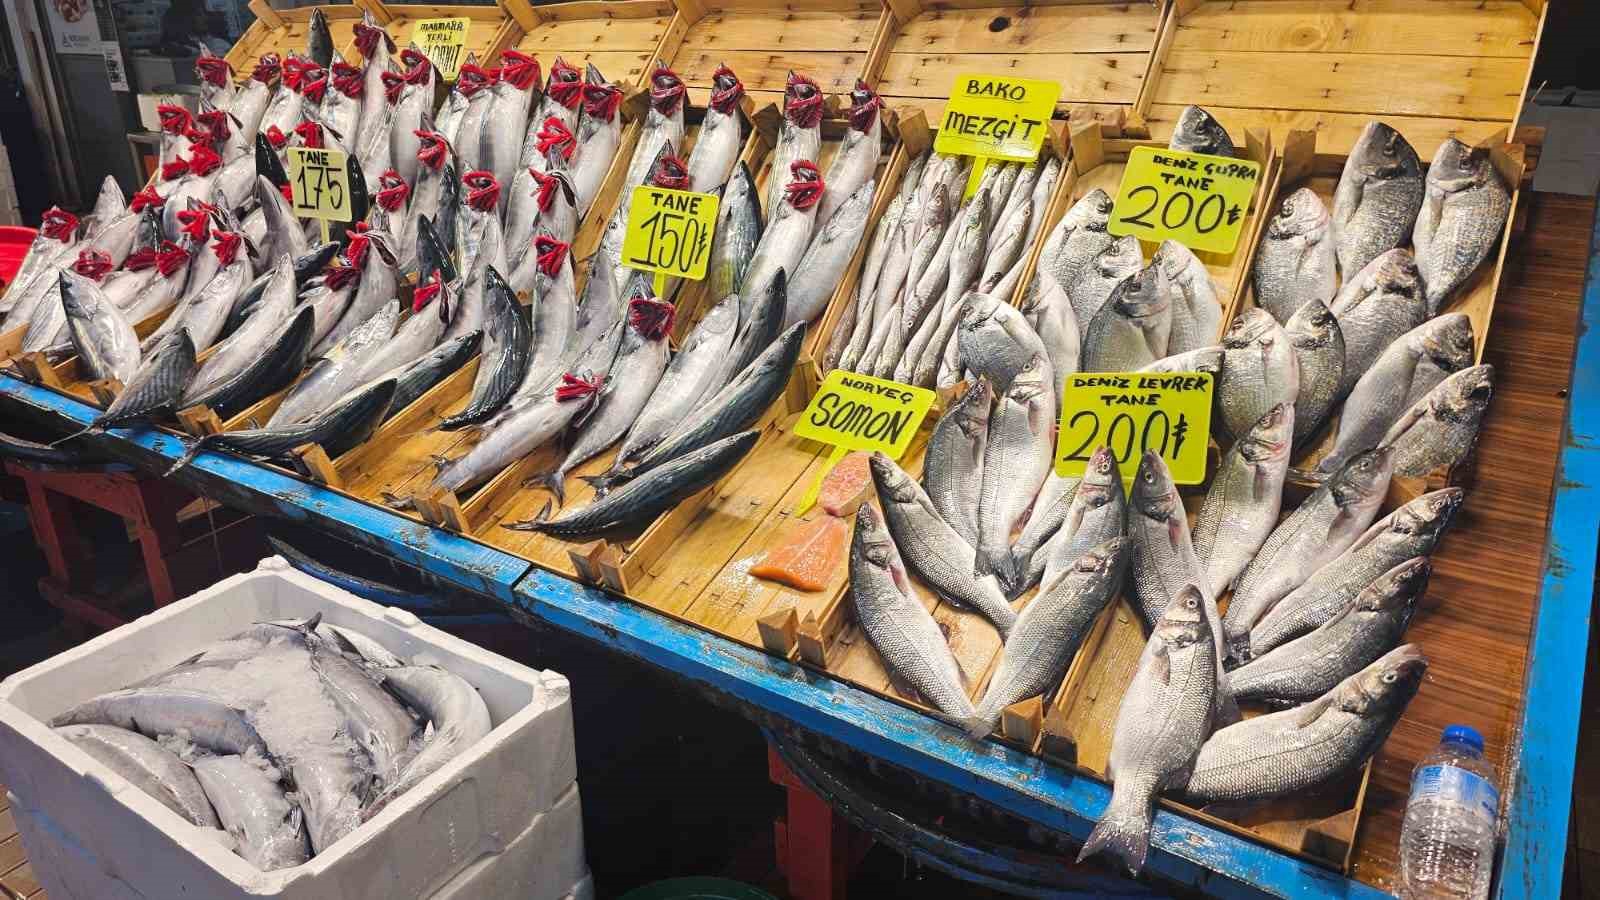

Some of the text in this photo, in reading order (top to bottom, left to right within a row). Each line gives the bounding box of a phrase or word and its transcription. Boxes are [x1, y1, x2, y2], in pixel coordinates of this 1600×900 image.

[966, 79, 1026, 100] BAKO
[945, 111, 1042, 142] MEZGİT
[298, 151, 328, 166] TANE
[297, 166, 342, 210] 175
[1160, 172, 1214, 191] TANE
[651, 192, 703, 215] TANE
[841, 377, 914, 405] NORVEÇ
[1074, 376, 1209, 392] DENİZ LEVREK
[1100, 393, 1161, 406] TANE
[810, 392, 914, 445] SOMON
